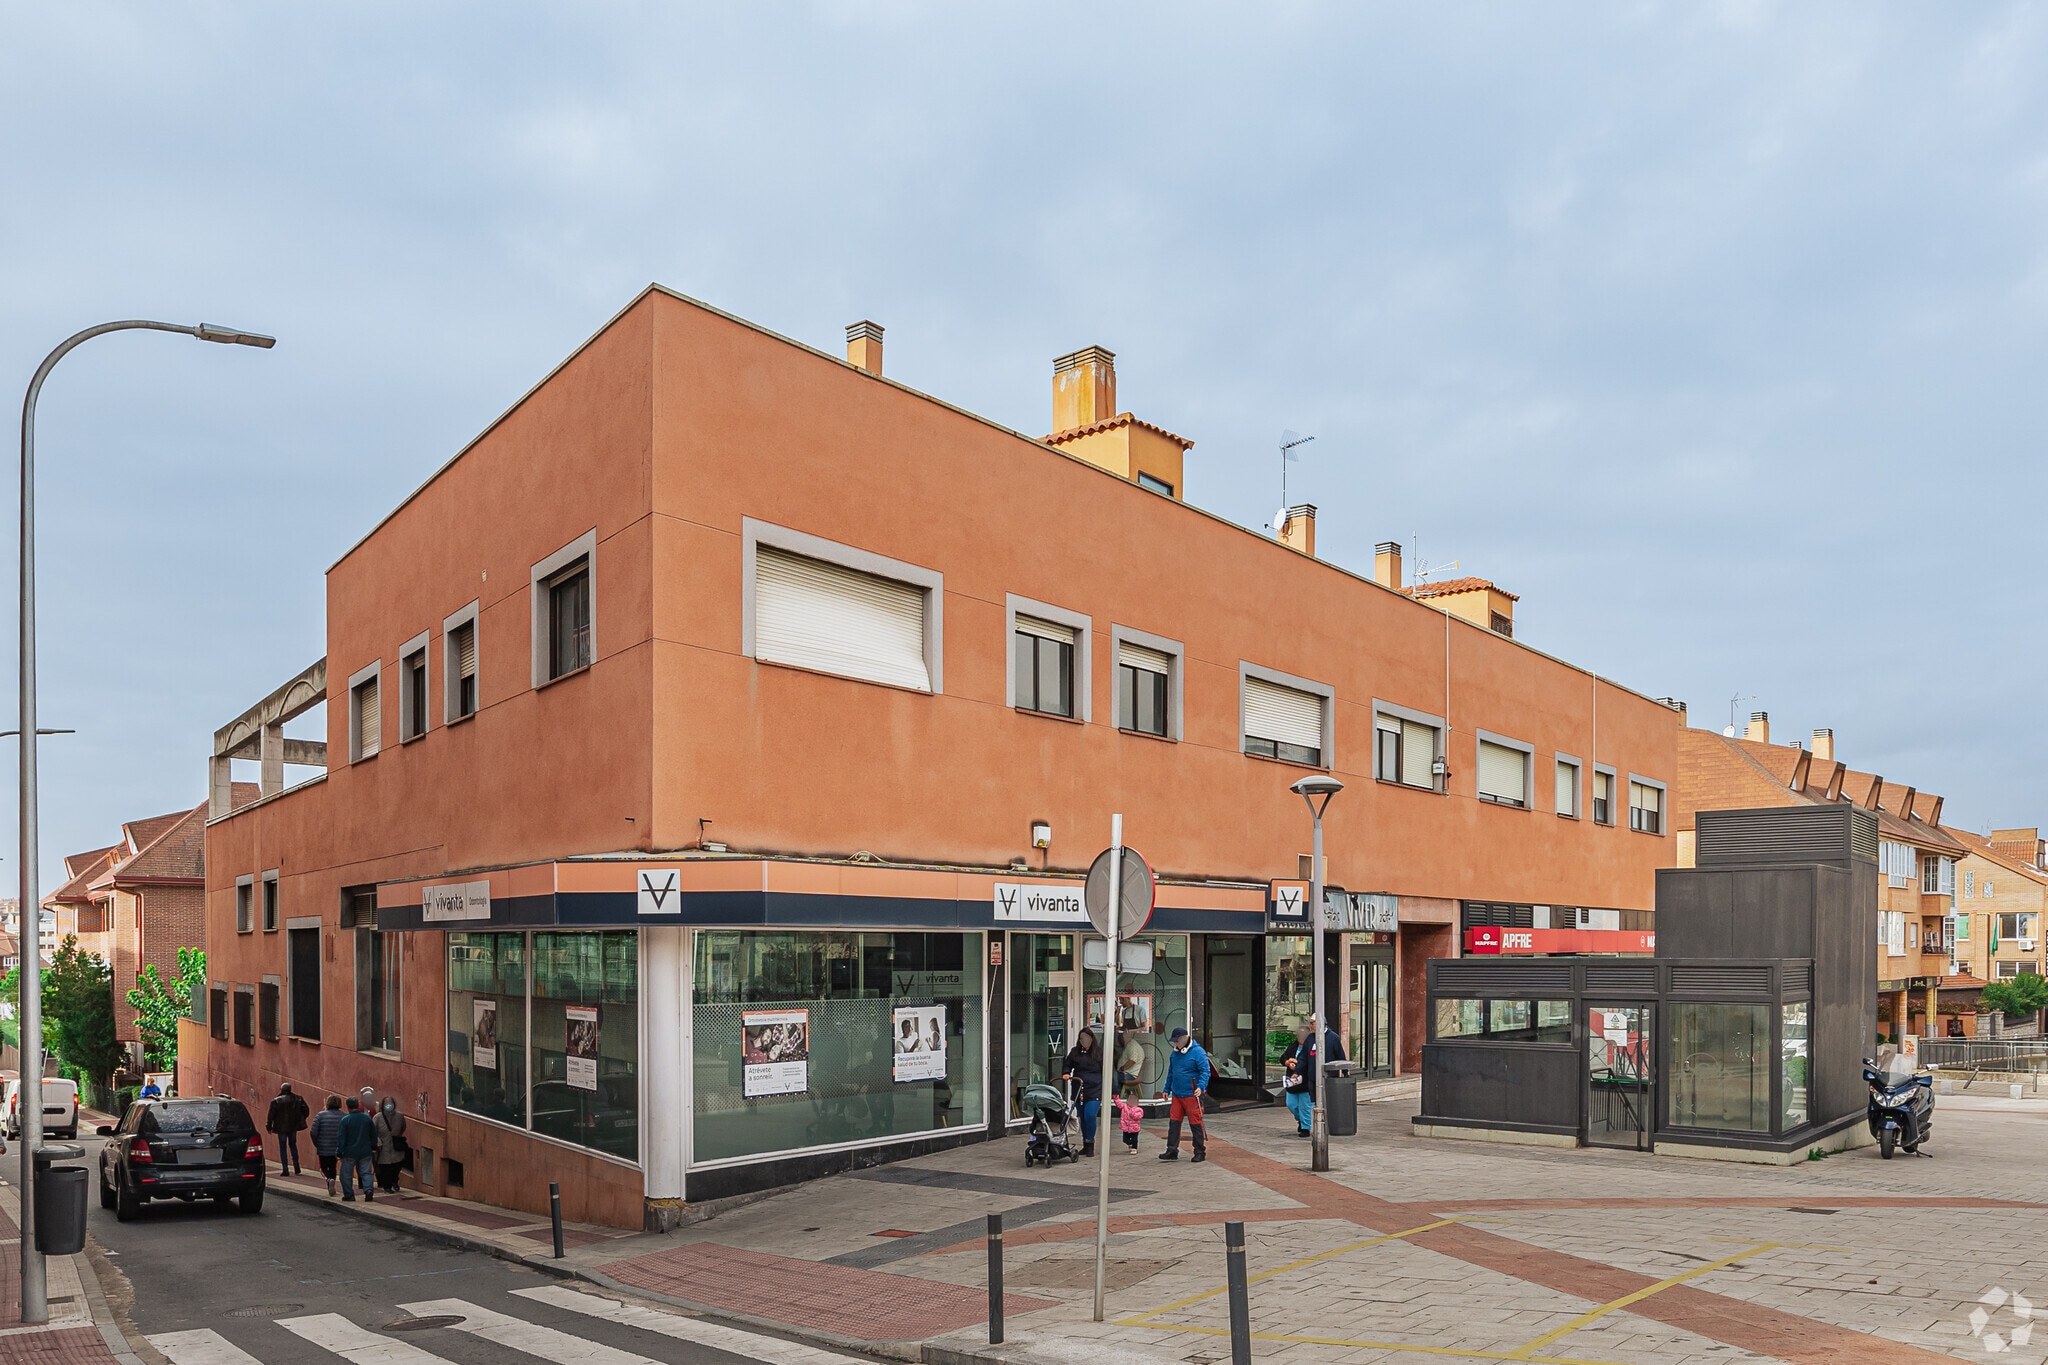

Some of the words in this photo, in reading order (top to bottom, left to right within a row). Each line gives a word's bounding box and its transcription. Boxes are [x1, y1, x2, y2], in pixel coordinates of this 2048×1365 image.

[436, 893, 463, 911] vivanta
[1027, 892, 1080, 912] vivanta
[1502, 933, 1533, 949] APFRE
[925, 973, 960, 984] vivanta
